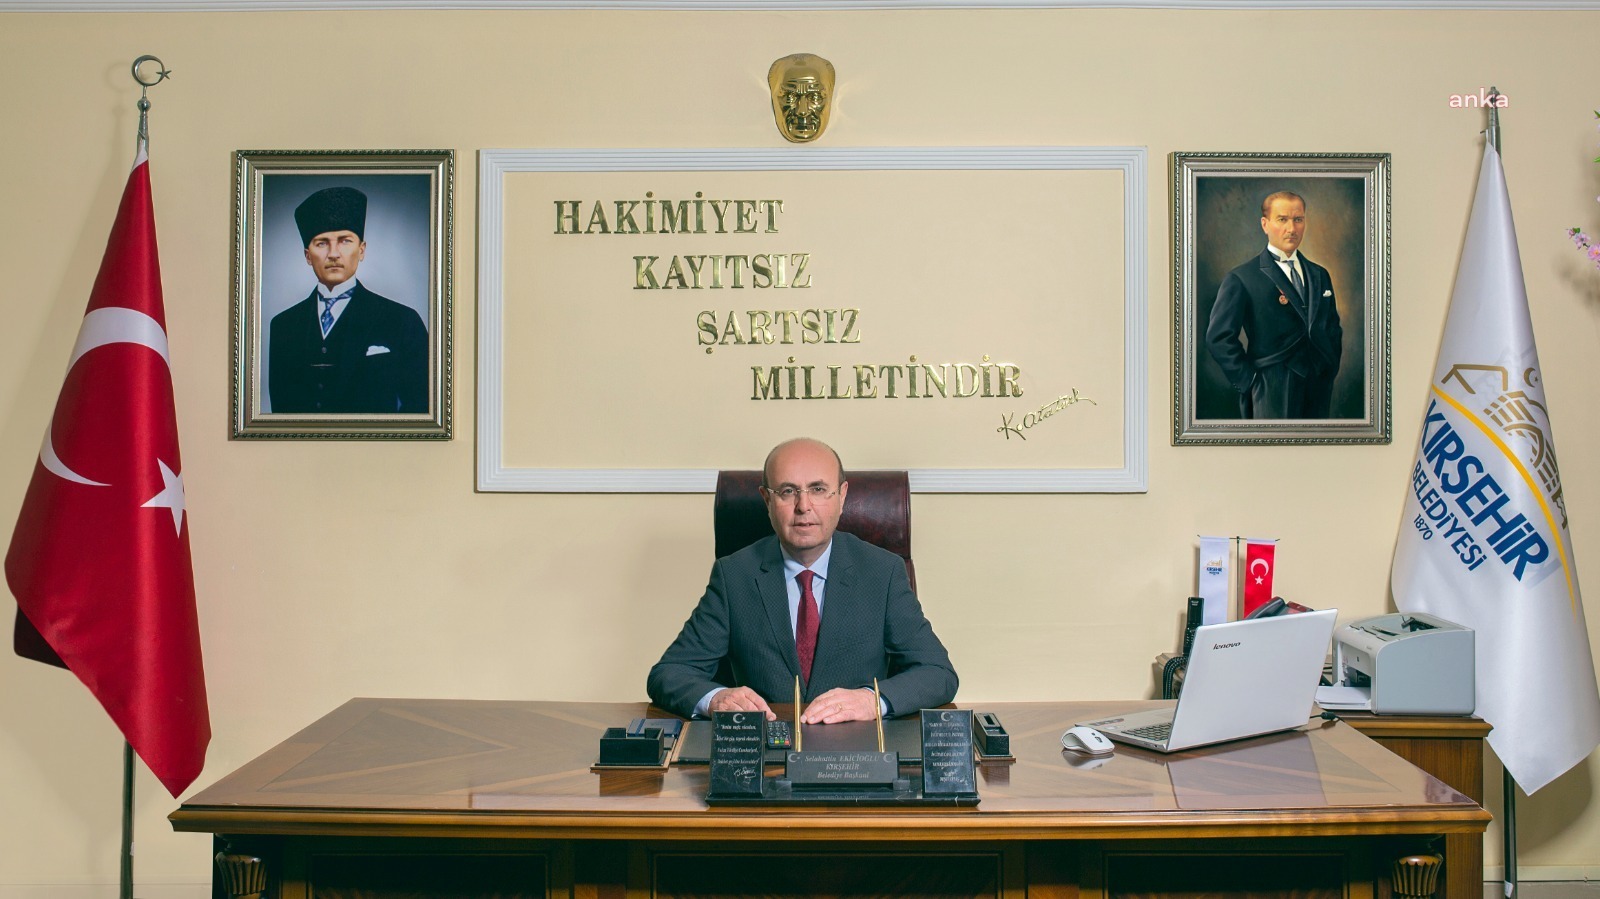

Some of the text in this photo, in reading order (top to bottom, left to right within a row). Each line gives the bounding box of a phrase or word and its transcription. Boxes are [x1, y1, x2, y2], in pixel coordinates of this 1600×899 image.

[553, 190, 784, 234] HAKİMİYET
[632, 253, 812, 290] KAYITSIZ
[696, 308, 861, 355] ŞARTSIZ
[750, 354, 1024, 401] MİLLETİNDİR
[1413, 513, 1433, 541] 1870
[1213, 642, 1241, 650] lenovo
